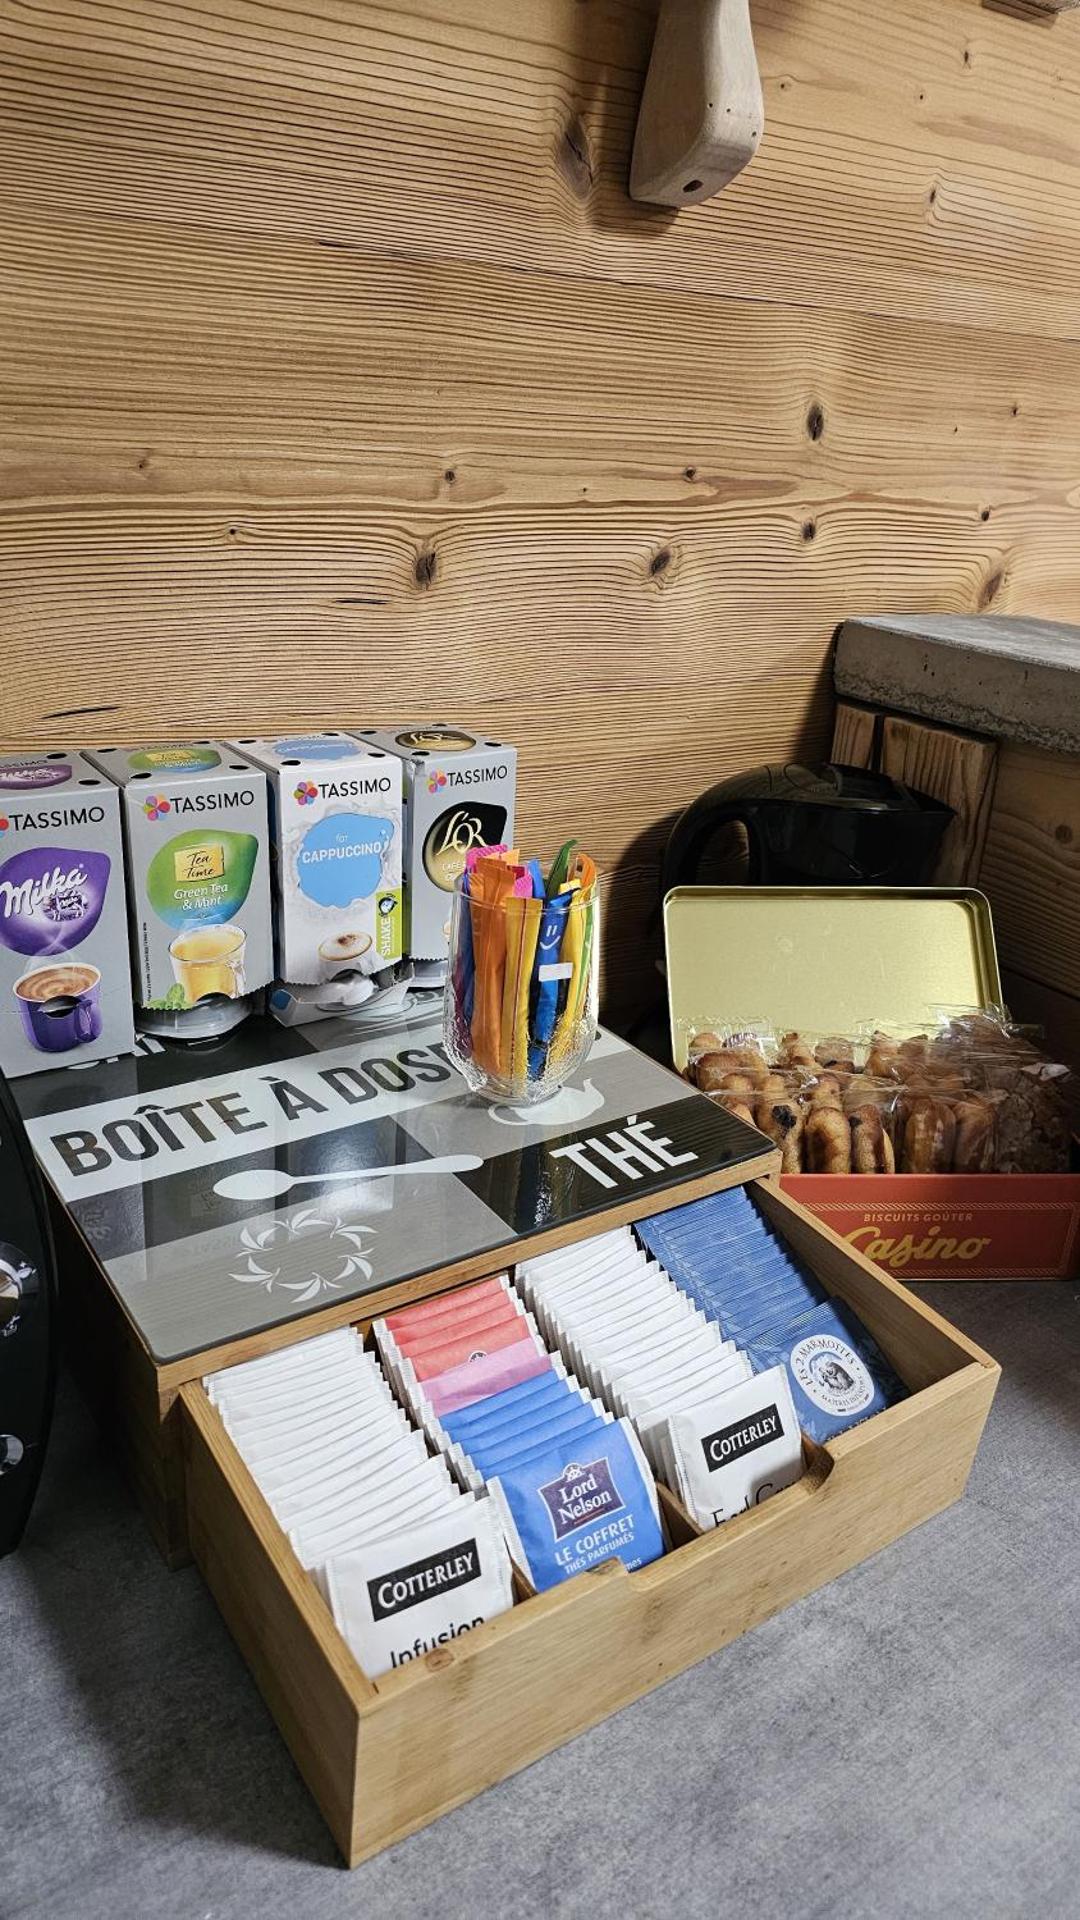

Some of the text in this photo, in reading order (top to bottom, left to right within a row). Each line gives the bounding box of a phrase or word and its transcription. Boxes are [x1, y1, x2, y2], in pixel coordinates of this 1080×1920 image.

[318, 777, 391, 799] TASSIMO
[447, 765, 508, 787] TASSIMO
[170, 790, 254, 814] TASSIMO
[9, 806, 105, 832] TASSIMO
[436, 810, 487, 856] L'OR
[186, 850, 210, 867] Tea
[302, 841, 382, 864] CAPPUCCINO
[183, 867, 214, 879] Time
[0, 866, 88, 918] Milka
[174, 884, 229, 900] Green Tea
[182, 896, 224, 911] & Mint
[381, 915, 391, 956] SHAKE
[50, 1042, 463, 1177] BOÎTE À DOS
[549, 1114, 699, 1189] THÉ
[863, 1213, 920, 1222] BISCUITS
[799, 1338, 857, 1365] MARMOTTES
[709, 1415, 777, 1462] COTTERLEY
[558, 1473, 599, 1504] Lord
[558, 1490, 613, 1525] Nelson
[711, 1494, 751, 1527] El
[554, 1514, 634, 1566] LE COFFRET
[587, 1531, 635, 1562] PARFUMÉS
[377, 1551, 474, 1609] COTTERLEY
